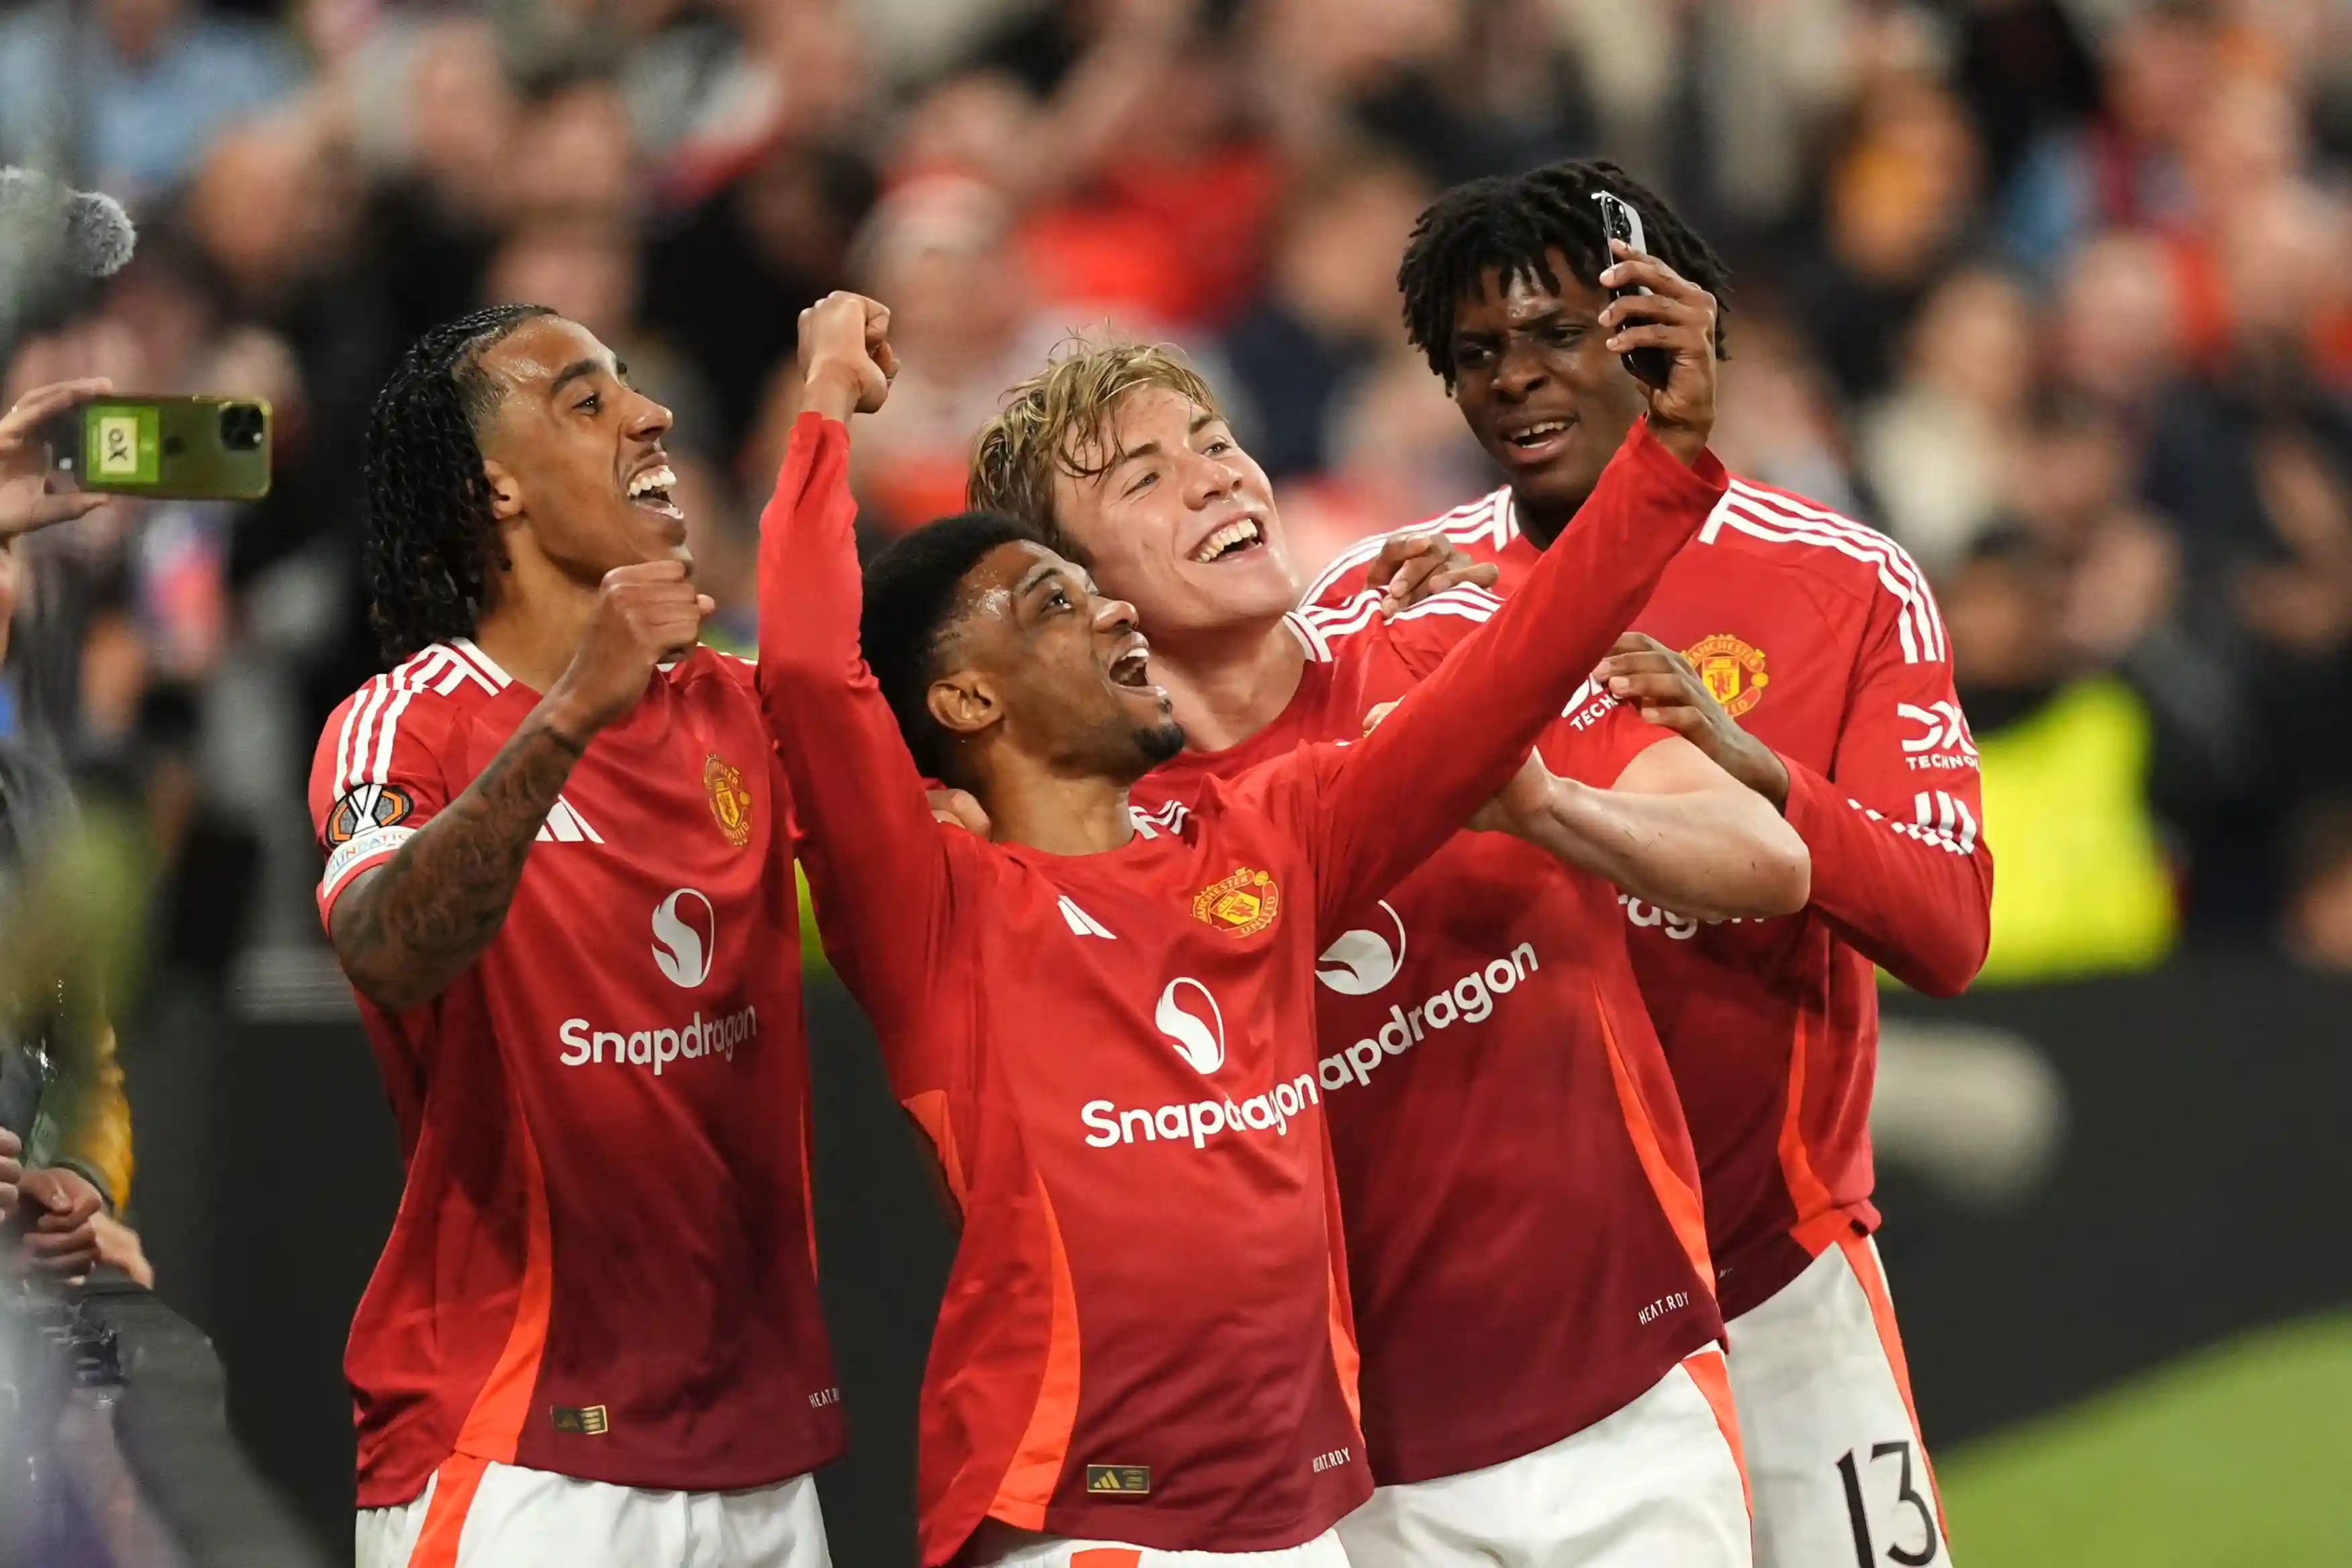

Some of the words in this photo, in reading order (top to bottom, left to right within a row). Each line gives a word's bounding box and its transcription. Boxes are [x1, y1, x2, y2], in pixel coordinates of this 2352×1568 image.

[1569, 693, 1618, 731] TECH
[560, 1004, 757, 1076] Snapdragon
[1318, 942, 1539, 1090] apdragon
[1081, 1073, 1319, 1148] Snapdagon
[1638, 1291, 1689, 1326] HEAT.RDY
[1835, 1440, 1937, 1568] 13
